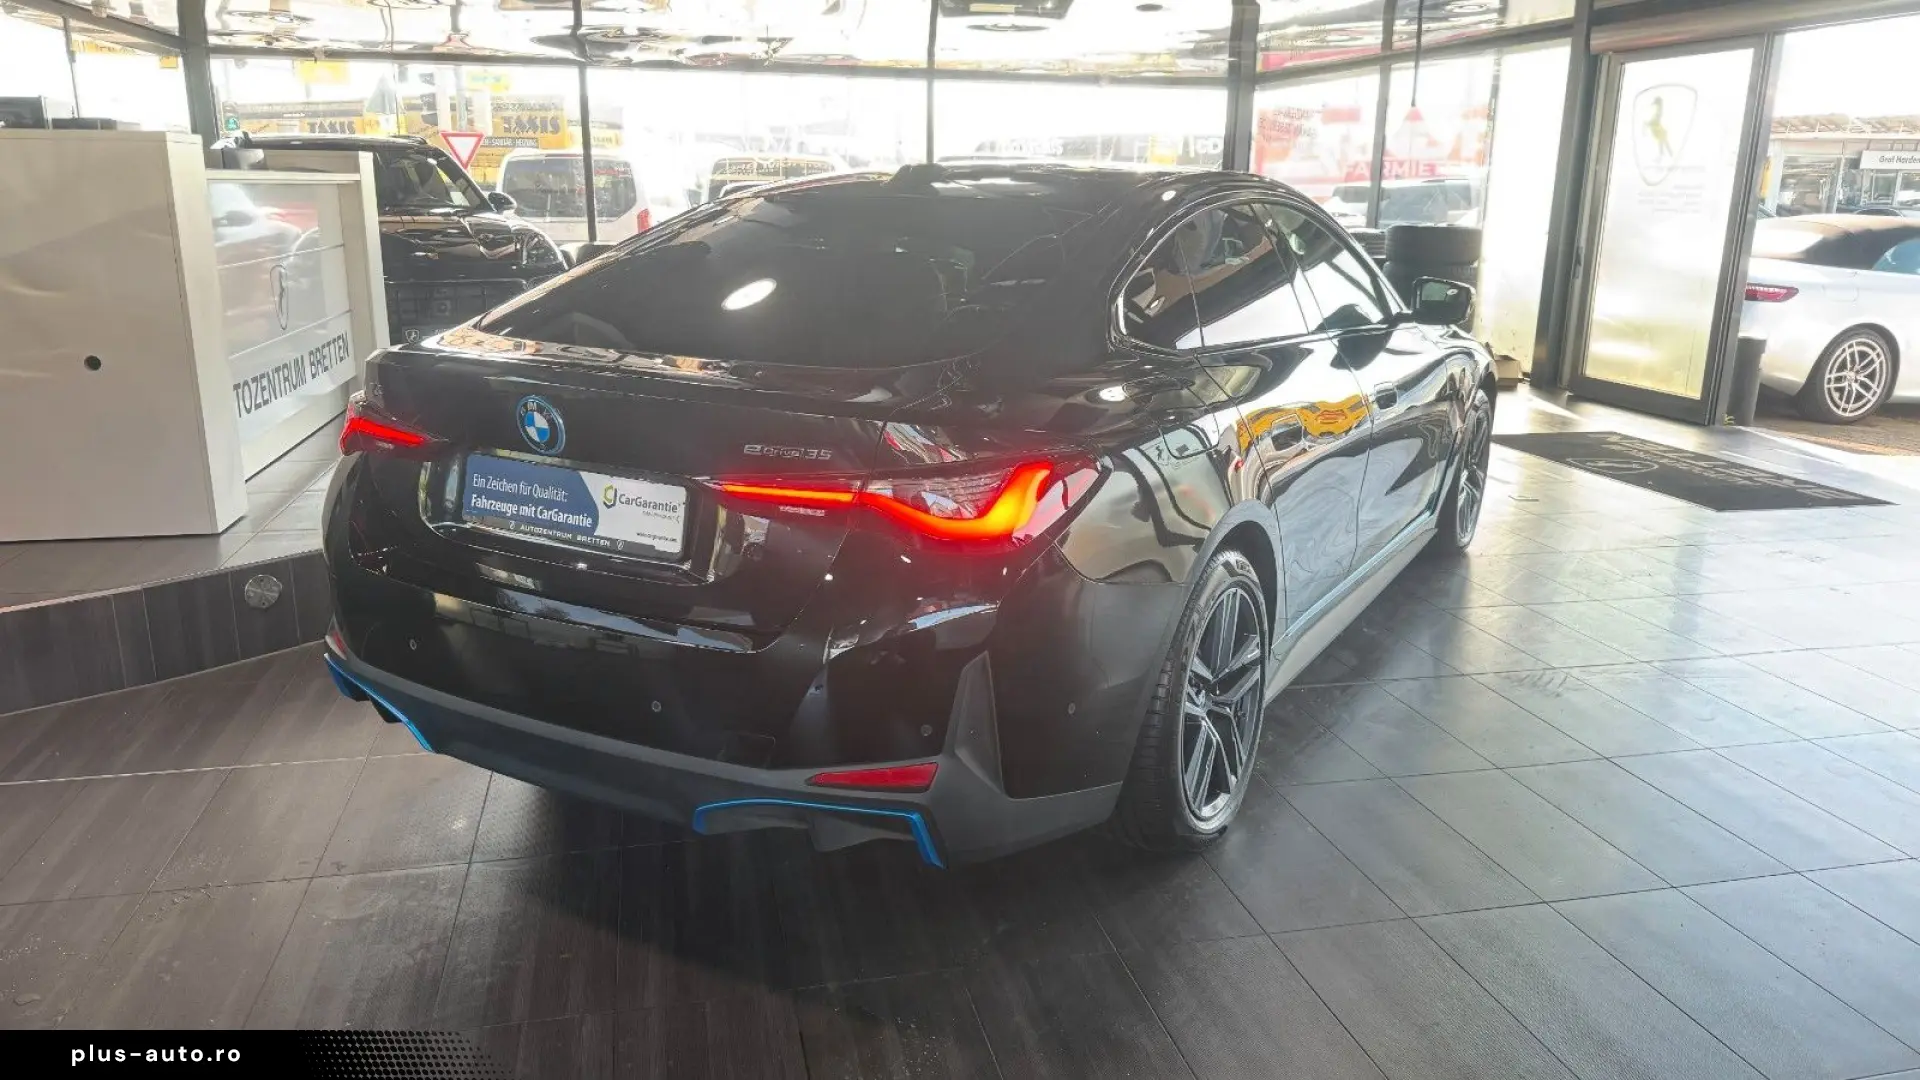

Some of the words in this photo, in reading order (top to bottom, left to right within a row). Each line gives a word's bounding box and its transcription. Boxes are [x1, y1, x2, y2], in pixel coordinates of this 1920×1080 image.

[232, 354, 307, 418] TOZENTRUM
[309, 331, 350, 380] BRETTEN
[473, 473, 486, 488] Ein
[486, 476, 518, 494] Zeichen
[519, 480, 531, 496] für
[532, 484, 568, 503] Qualität:
[618, 493, 678, 513] CarGarantie
[471, 493, 518, 517] Fahrzeuge
[519, 503, 535, 518] mit
[537, 505, 593, 528] CarGarantie
[520, 523, 573, 540] AUTOZENTRUM
[576, 534, 611, 547] BRETTEN
